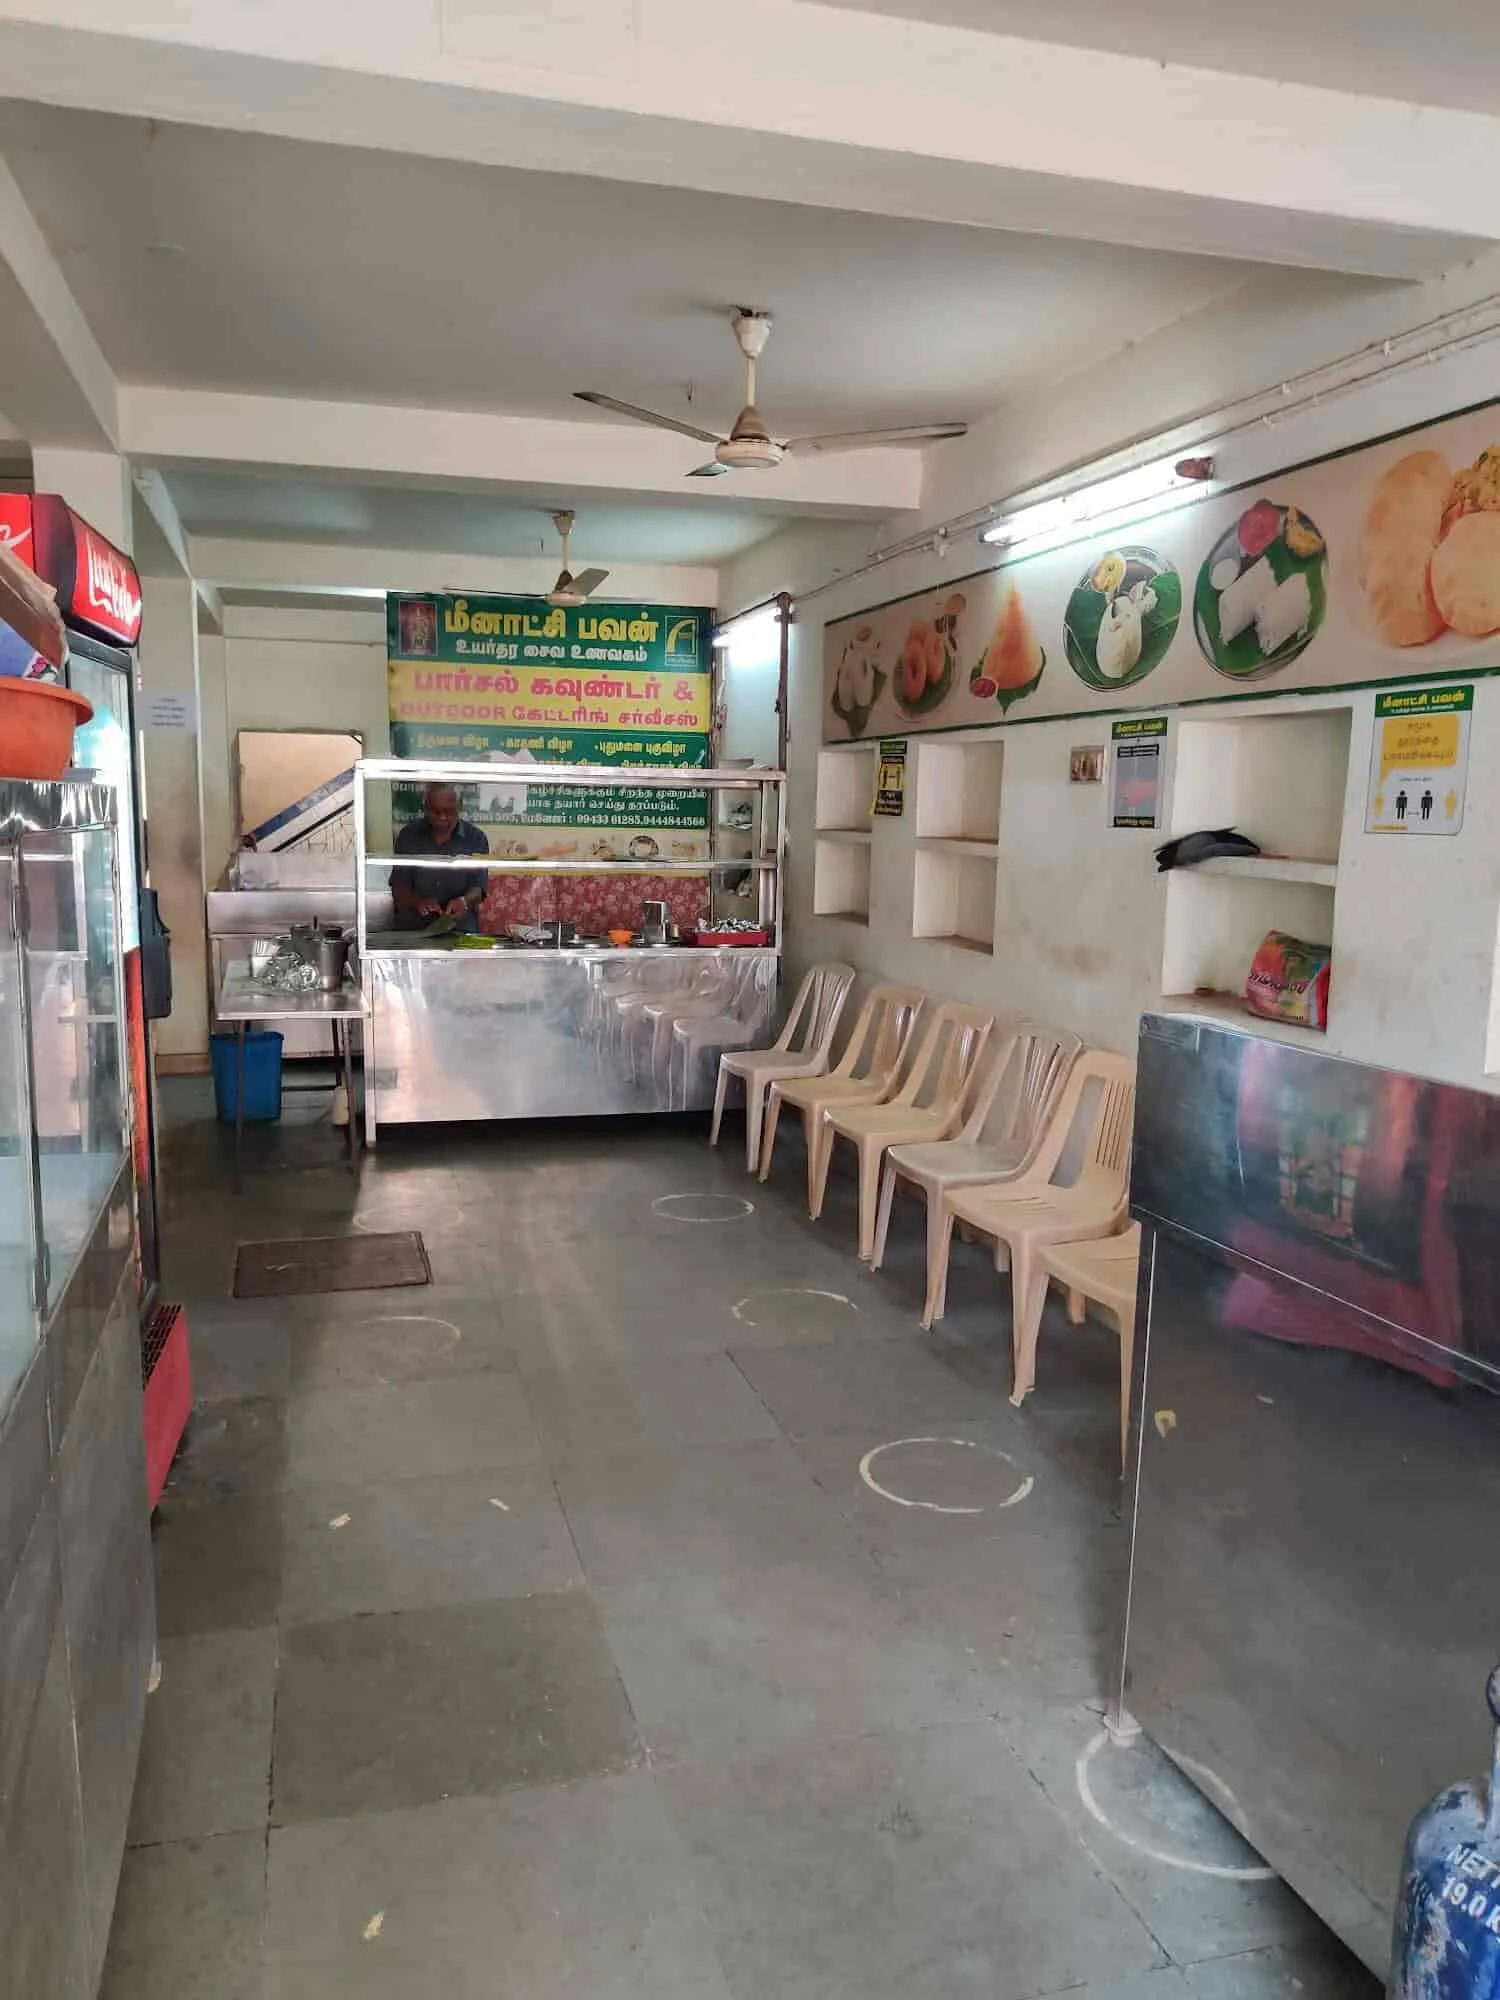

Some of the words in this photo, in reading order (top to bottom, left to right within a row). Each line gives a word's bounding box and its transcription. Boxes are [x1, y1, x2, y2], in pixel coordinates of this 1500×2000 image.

[444, 599, 566, 638] மீனாட்சி
[578, 612, 659, 642] பவன்
[456, 638, 519, 660] உயர்தர
[524, 644, 566, 659] சைவ
[571, 644, 648, 662] உணவகம்
[415, 667, 520, 694] பார்சல்
[530, 674, 662, 702] கவுண்டர்
[674, 680, 694, 701] &
[547, 737, 574, 753] விழா
